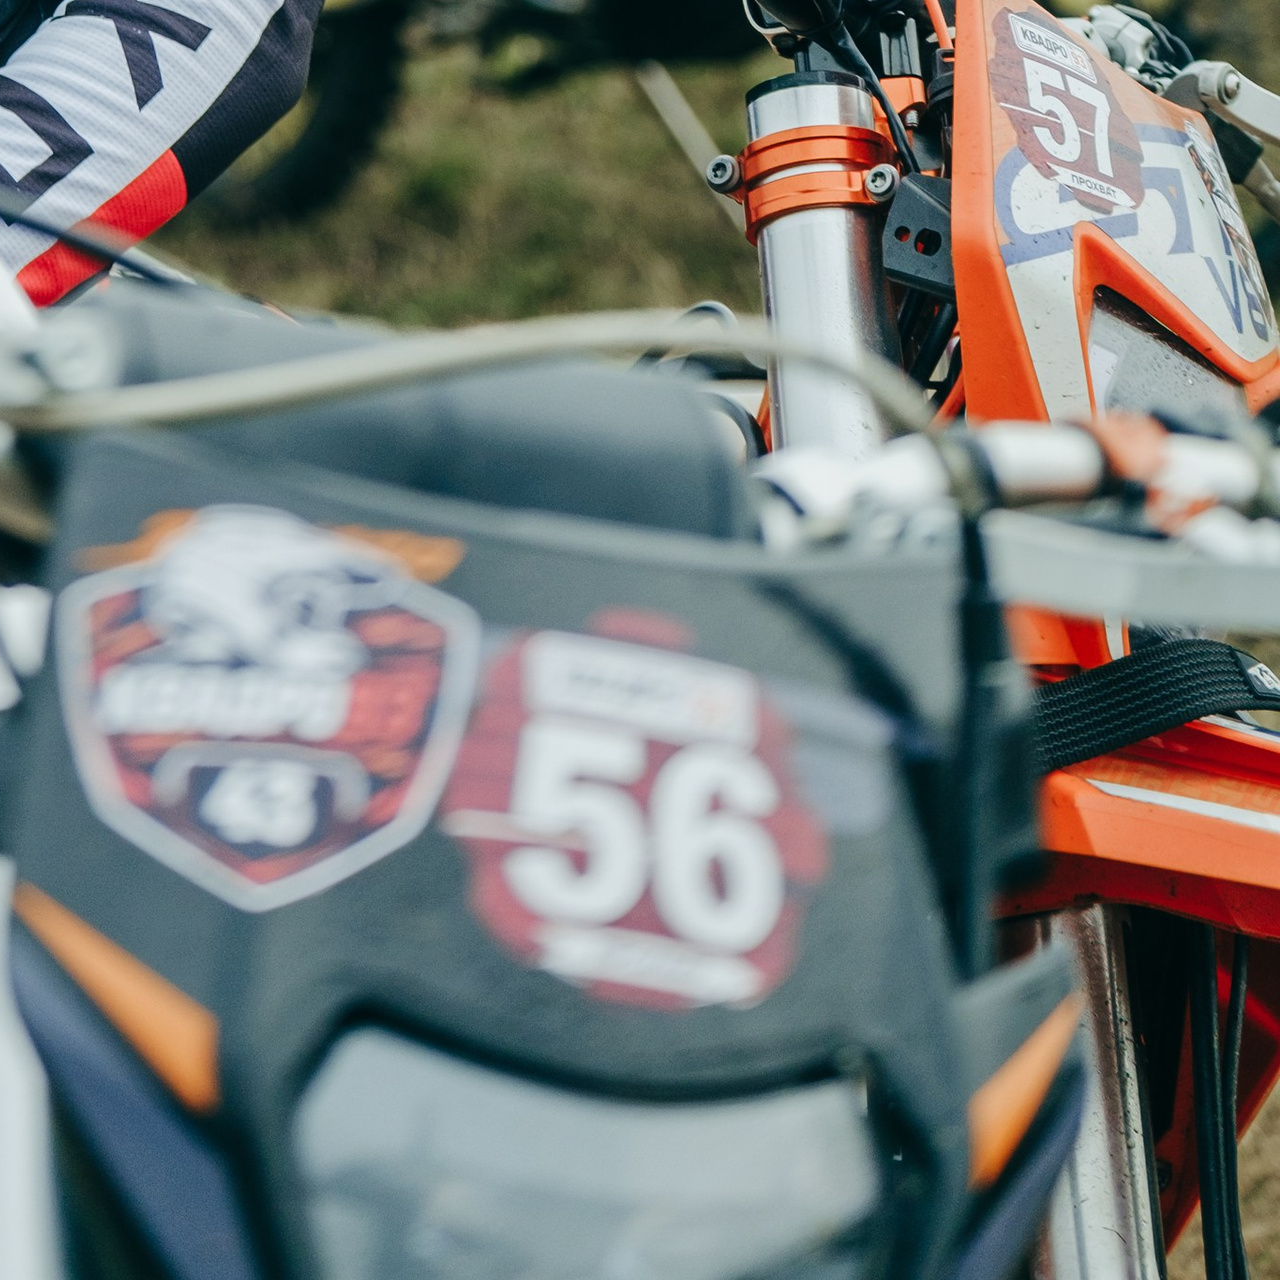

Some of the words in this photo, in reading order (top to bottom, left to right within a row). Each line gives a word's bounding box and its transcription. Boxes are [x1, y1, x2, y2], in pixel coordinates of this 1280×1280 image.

[1020, 27, 1068, 59] КВАДРО
[1070, 51, 1088, 70] 93
[1022, 57, 1114, 178] 57
[1071, 174, 1117, 200] ПРОХВАТ
[502, 715, 785, 956] 56
